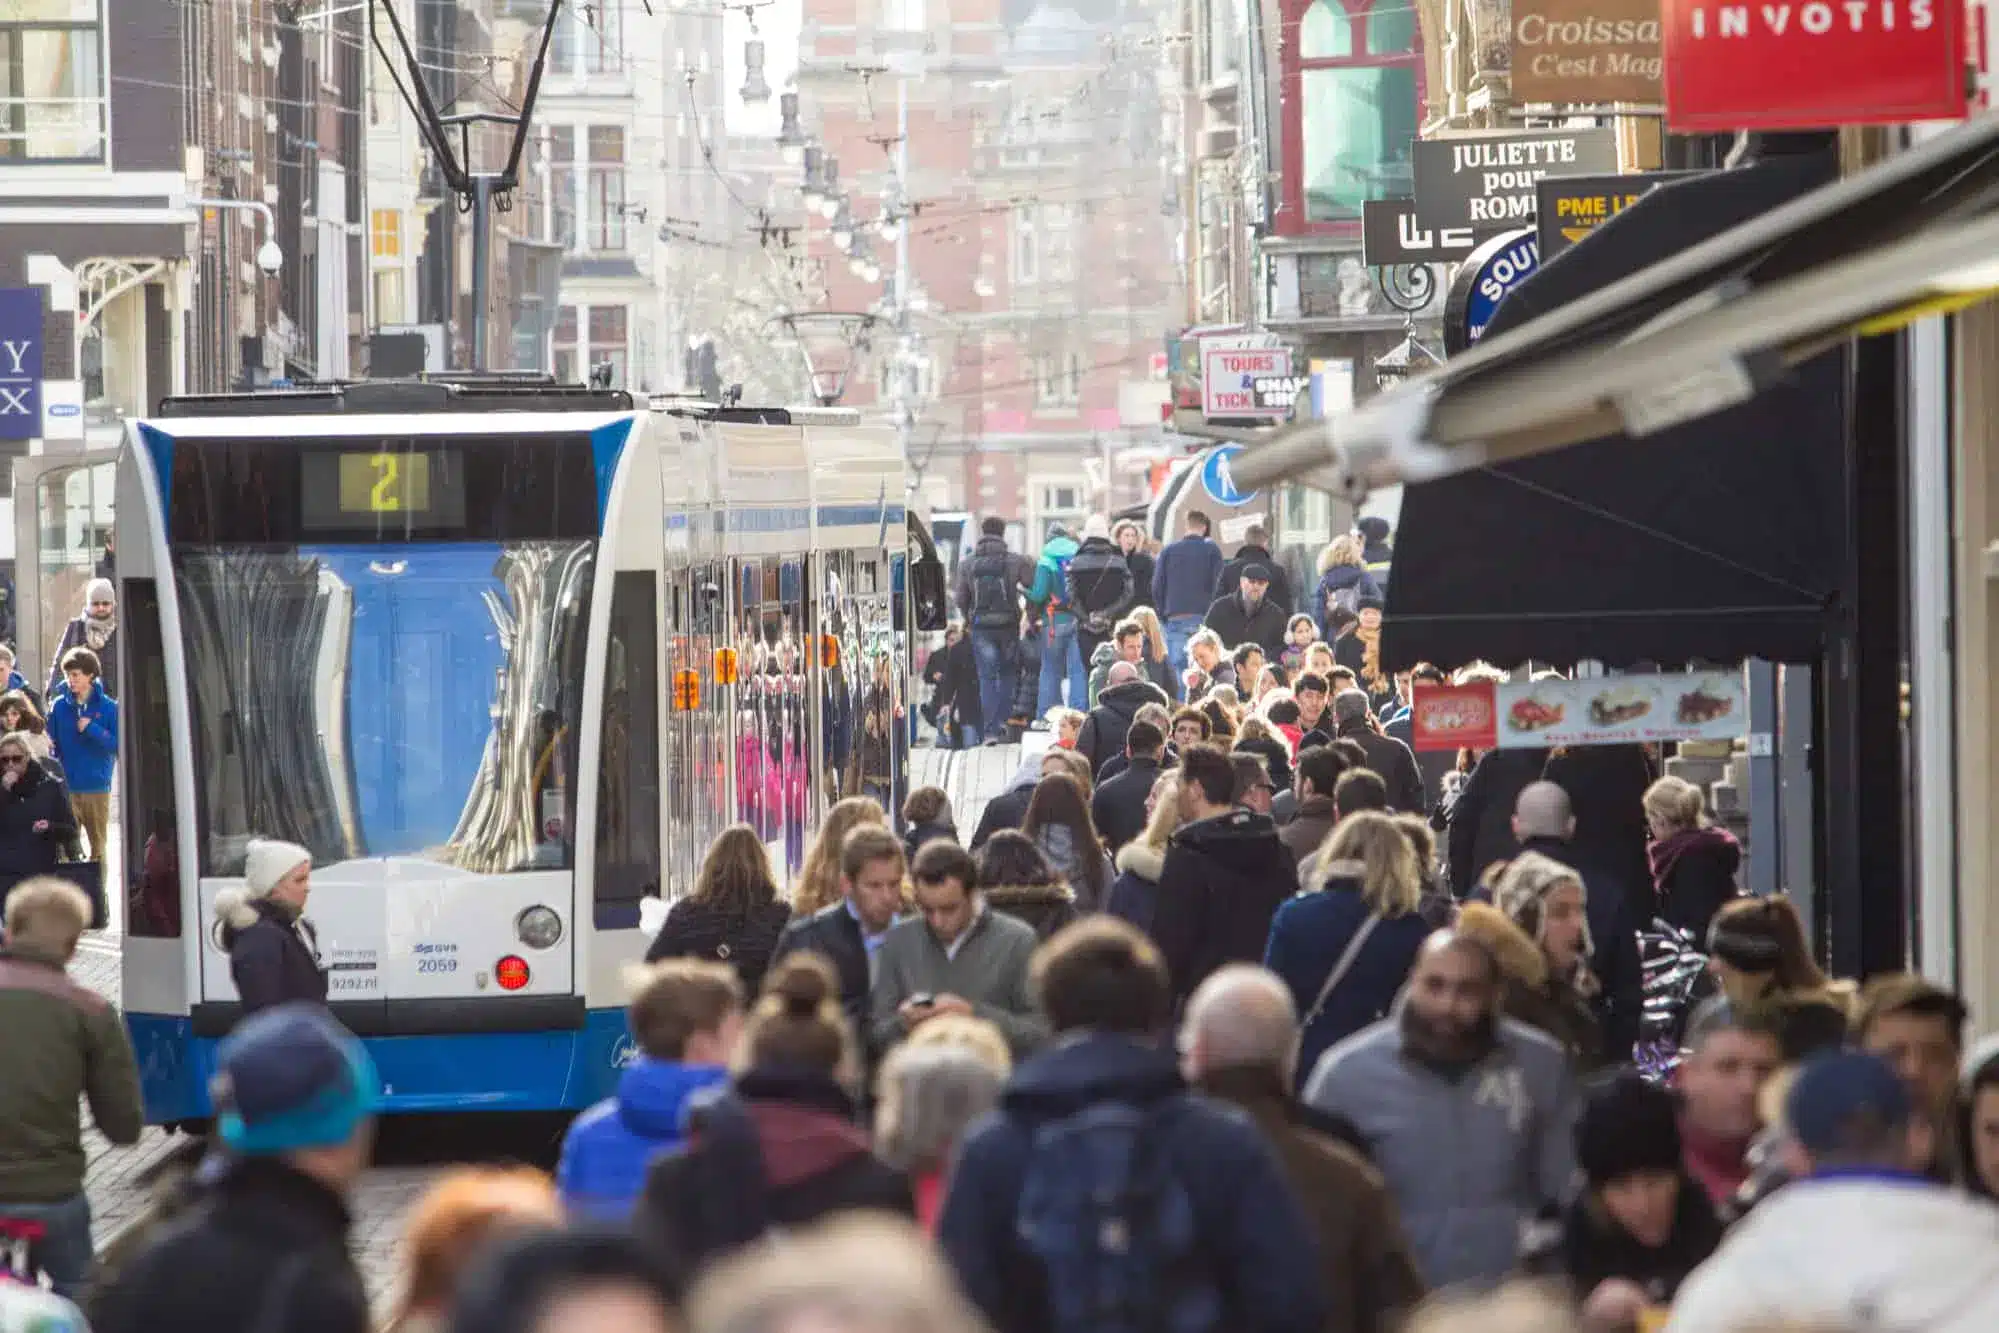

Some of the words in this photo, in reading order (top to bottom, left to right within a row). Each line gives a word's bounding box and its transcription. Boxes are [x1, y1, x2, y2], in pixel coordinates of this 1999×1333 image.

[1516, 14, 1661, 45] Croissa
[1692, 0, 1933, 39] INVOTIS
[1531, 53, 1599, 77] C'est
[1605, 53, 1664, 80] Mag
[1453, 139, 1576, 173] JULIETTE
[1470, 195, 1537, 220] ROM
[1557, 196, 1607, 216] PME
[3, 340, 32, 373] Y
[1223, 355, 1274, 373] TOURS
[0, 387, 32, 415] X
[371, 453, 398, 510] 2
[417, 959, 458, 973] 2059
